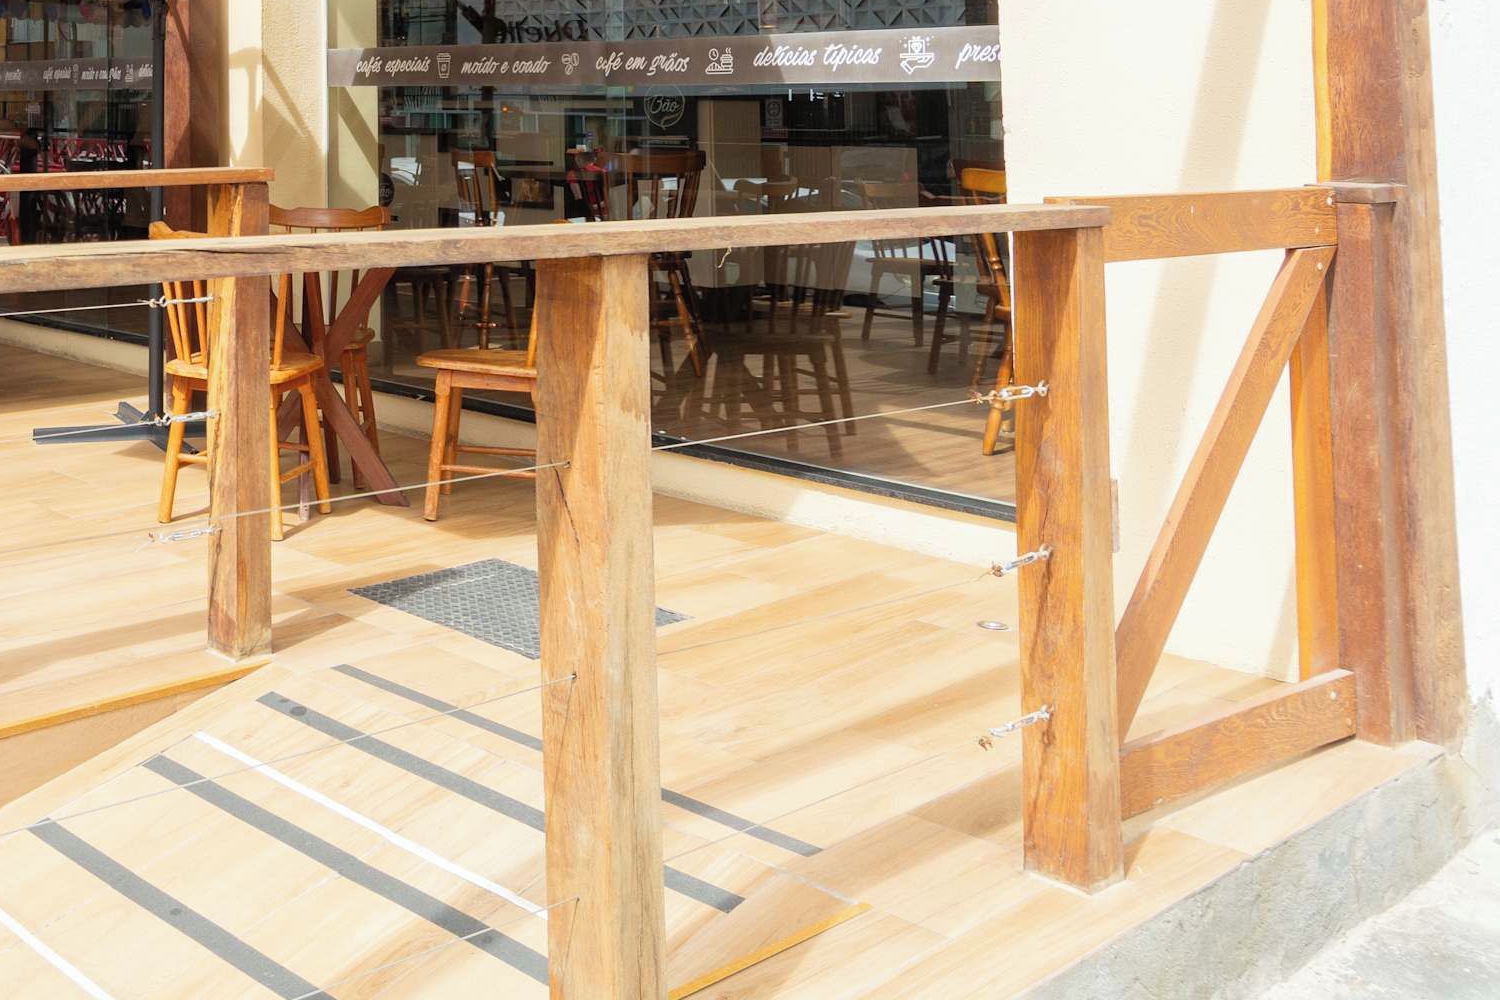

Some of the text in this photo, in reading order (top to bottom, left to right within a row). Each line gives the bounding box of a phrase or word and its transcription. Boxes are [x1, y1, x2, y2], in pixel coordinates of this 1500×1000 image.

[356, 56, 383, 78] cafés
[385, 56, 431, 77] especiais
[461, 56, 500, 74] moído
[500, 62, 509, 74] e
[512, 56, 552, 74] coado
[625, 58, 648, 71] em
[646, 52, 691, 76] grãos
[753, 45, 816, 67] delícias
[823, 43, 883, 72] típicas
